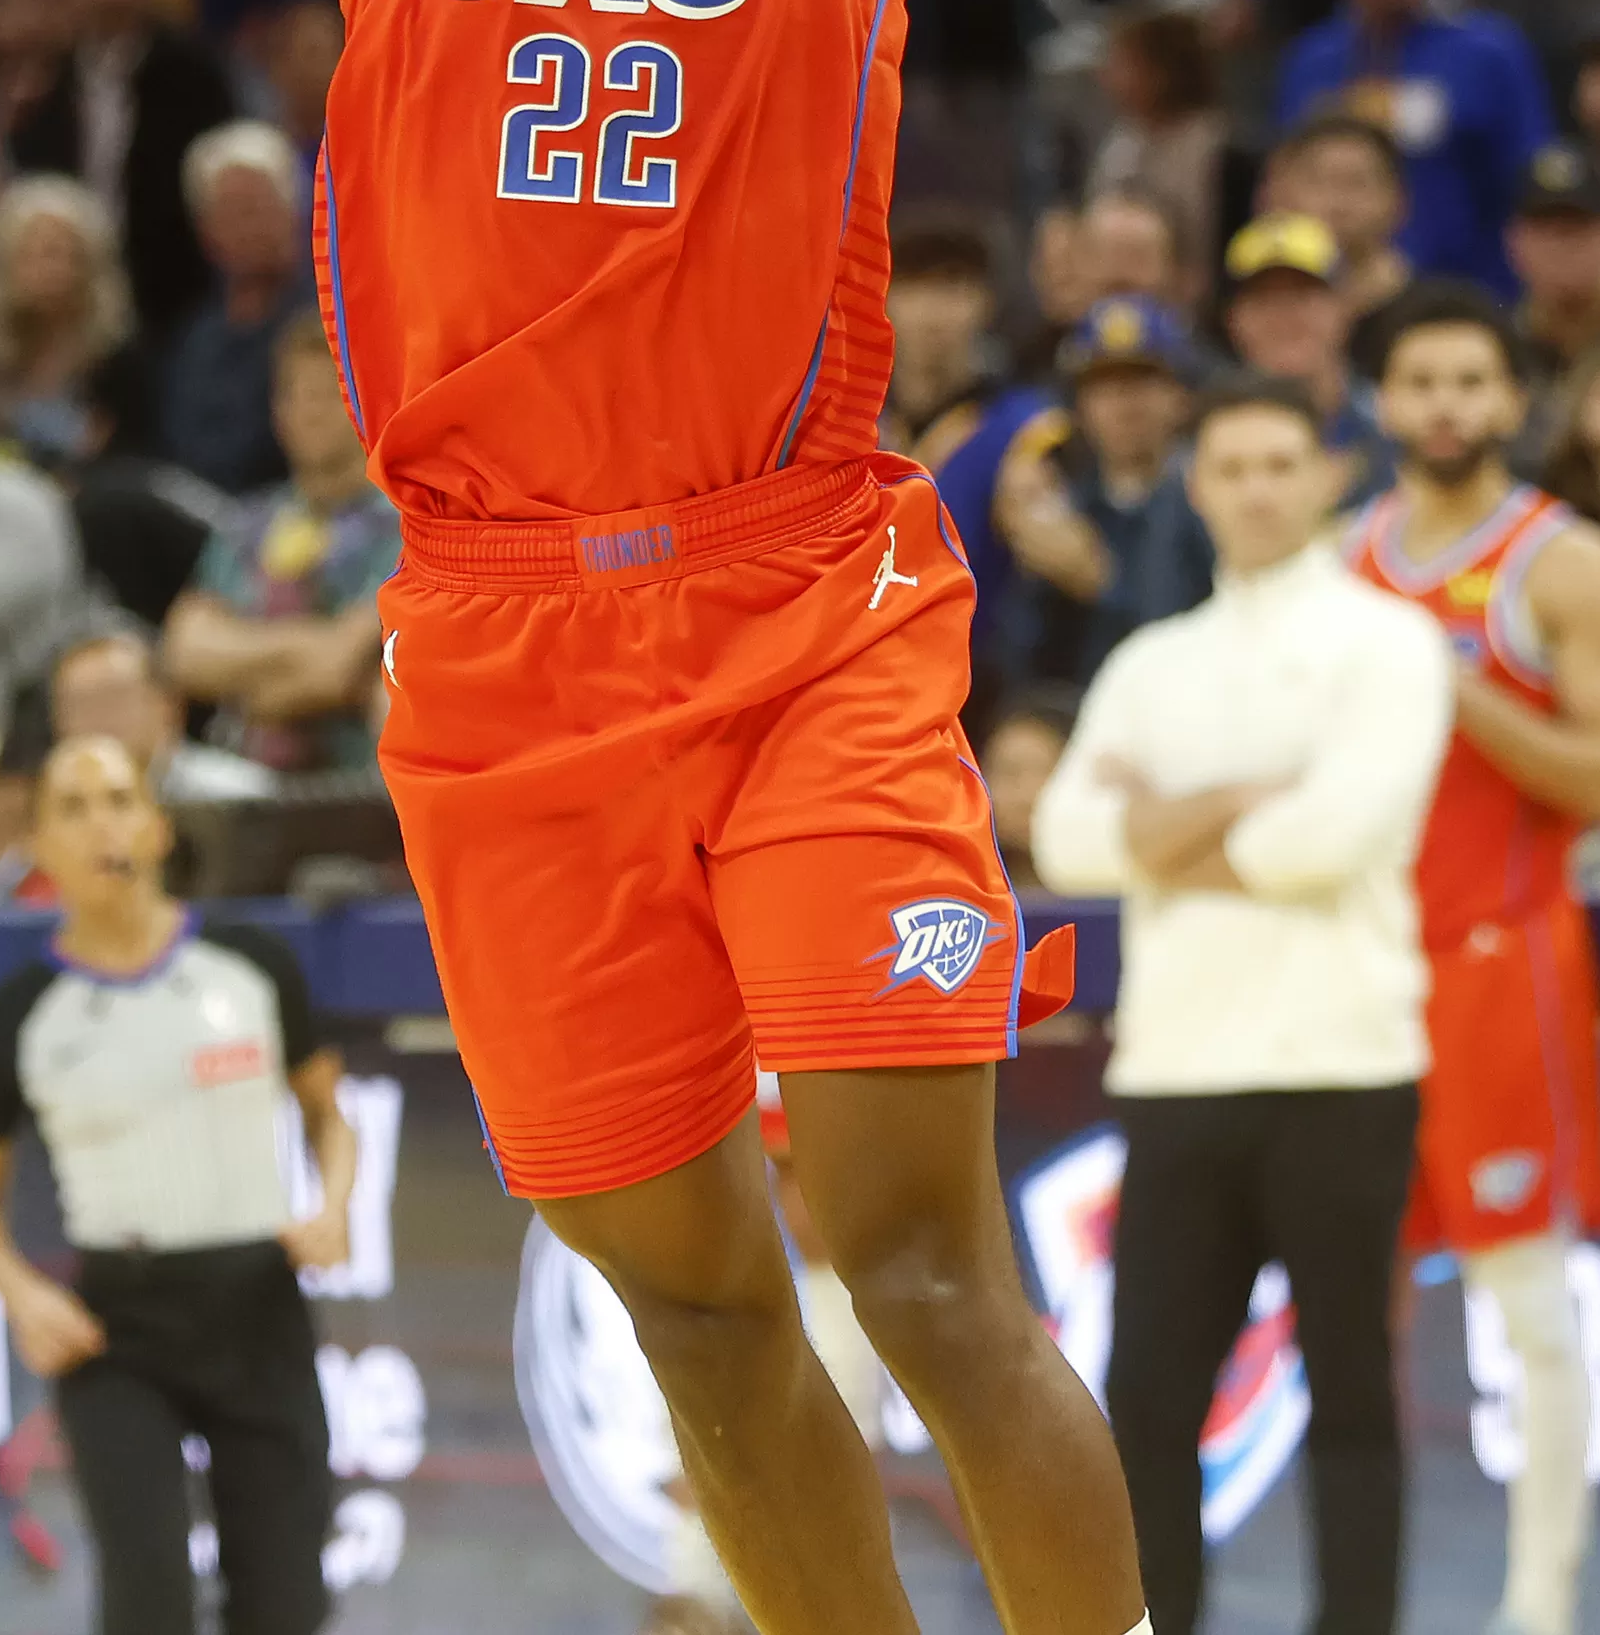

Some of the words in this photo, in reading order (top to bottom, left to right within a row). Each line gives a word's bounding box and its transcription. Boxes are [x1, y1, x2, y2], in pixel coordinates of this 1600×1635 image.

[496, 33, 683, 208] 22
[581, 525, 676, 573] THUNDER
[894, 919, 971, 974] OKC
